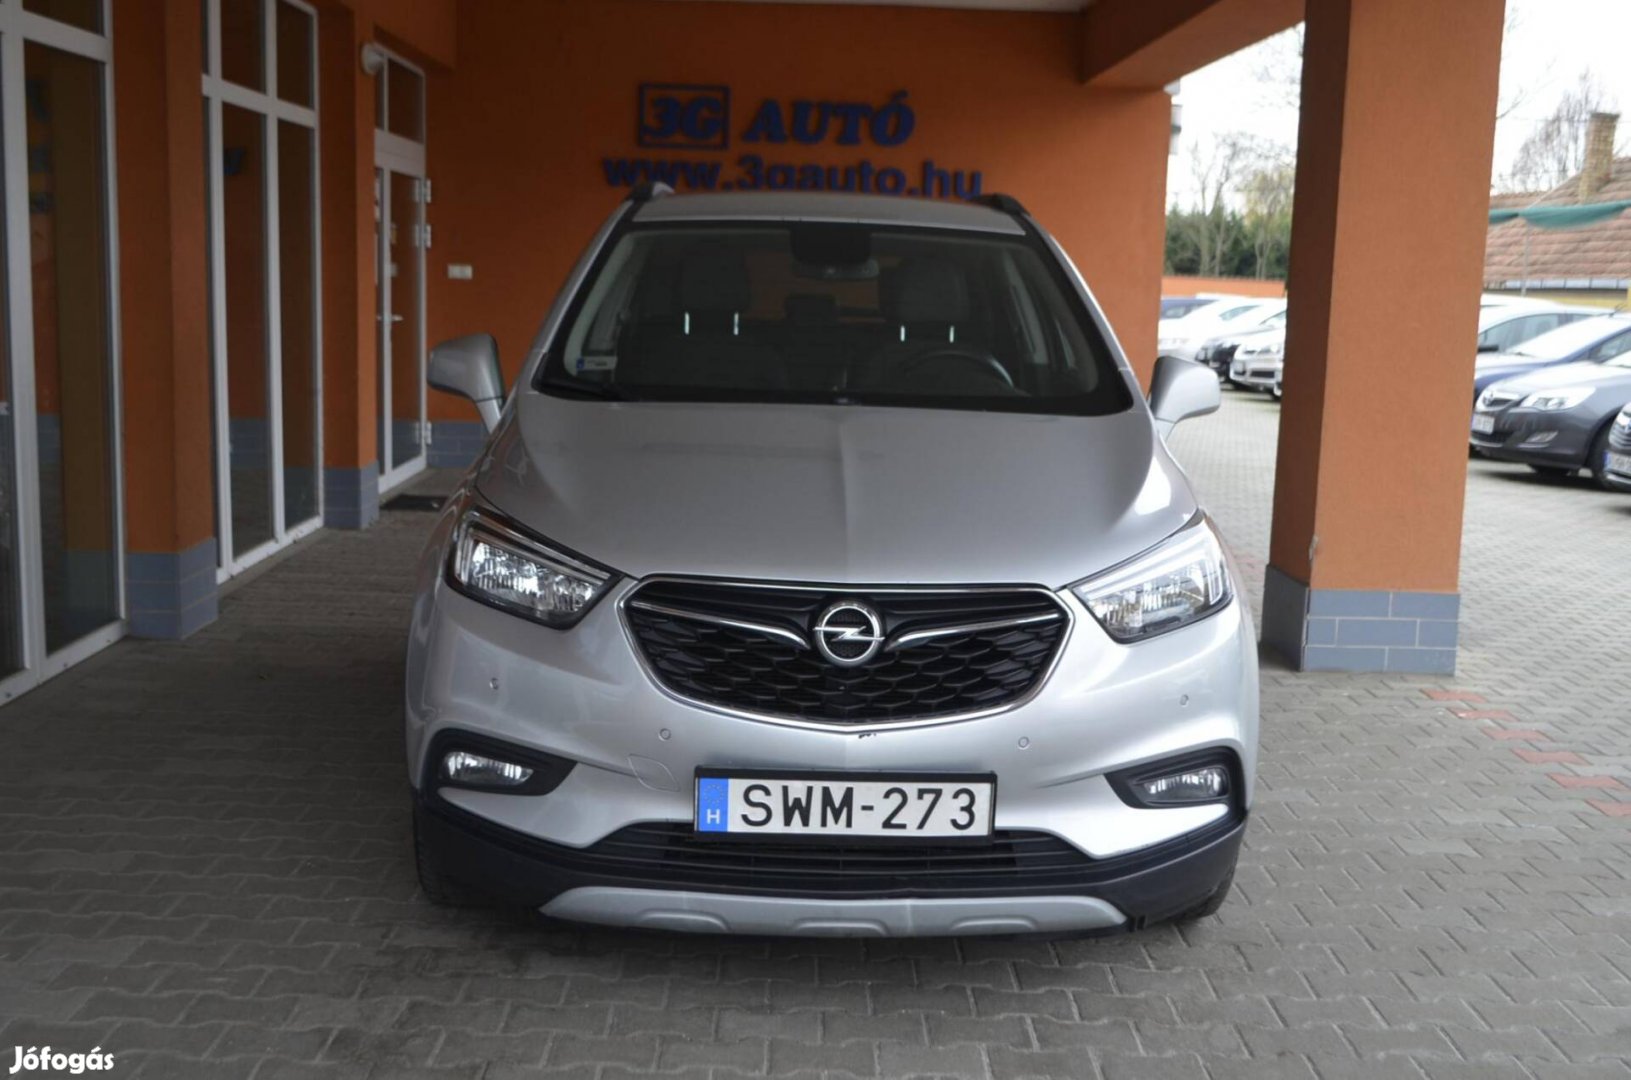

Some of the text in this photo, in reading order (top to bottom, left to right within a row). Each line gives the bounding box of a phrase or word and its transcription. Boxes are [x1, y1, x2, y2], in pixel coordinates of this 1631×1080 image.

[647, 90, 916, 146] 3G AUTÓ
[706, 784, 976, 831] H SWM-273
